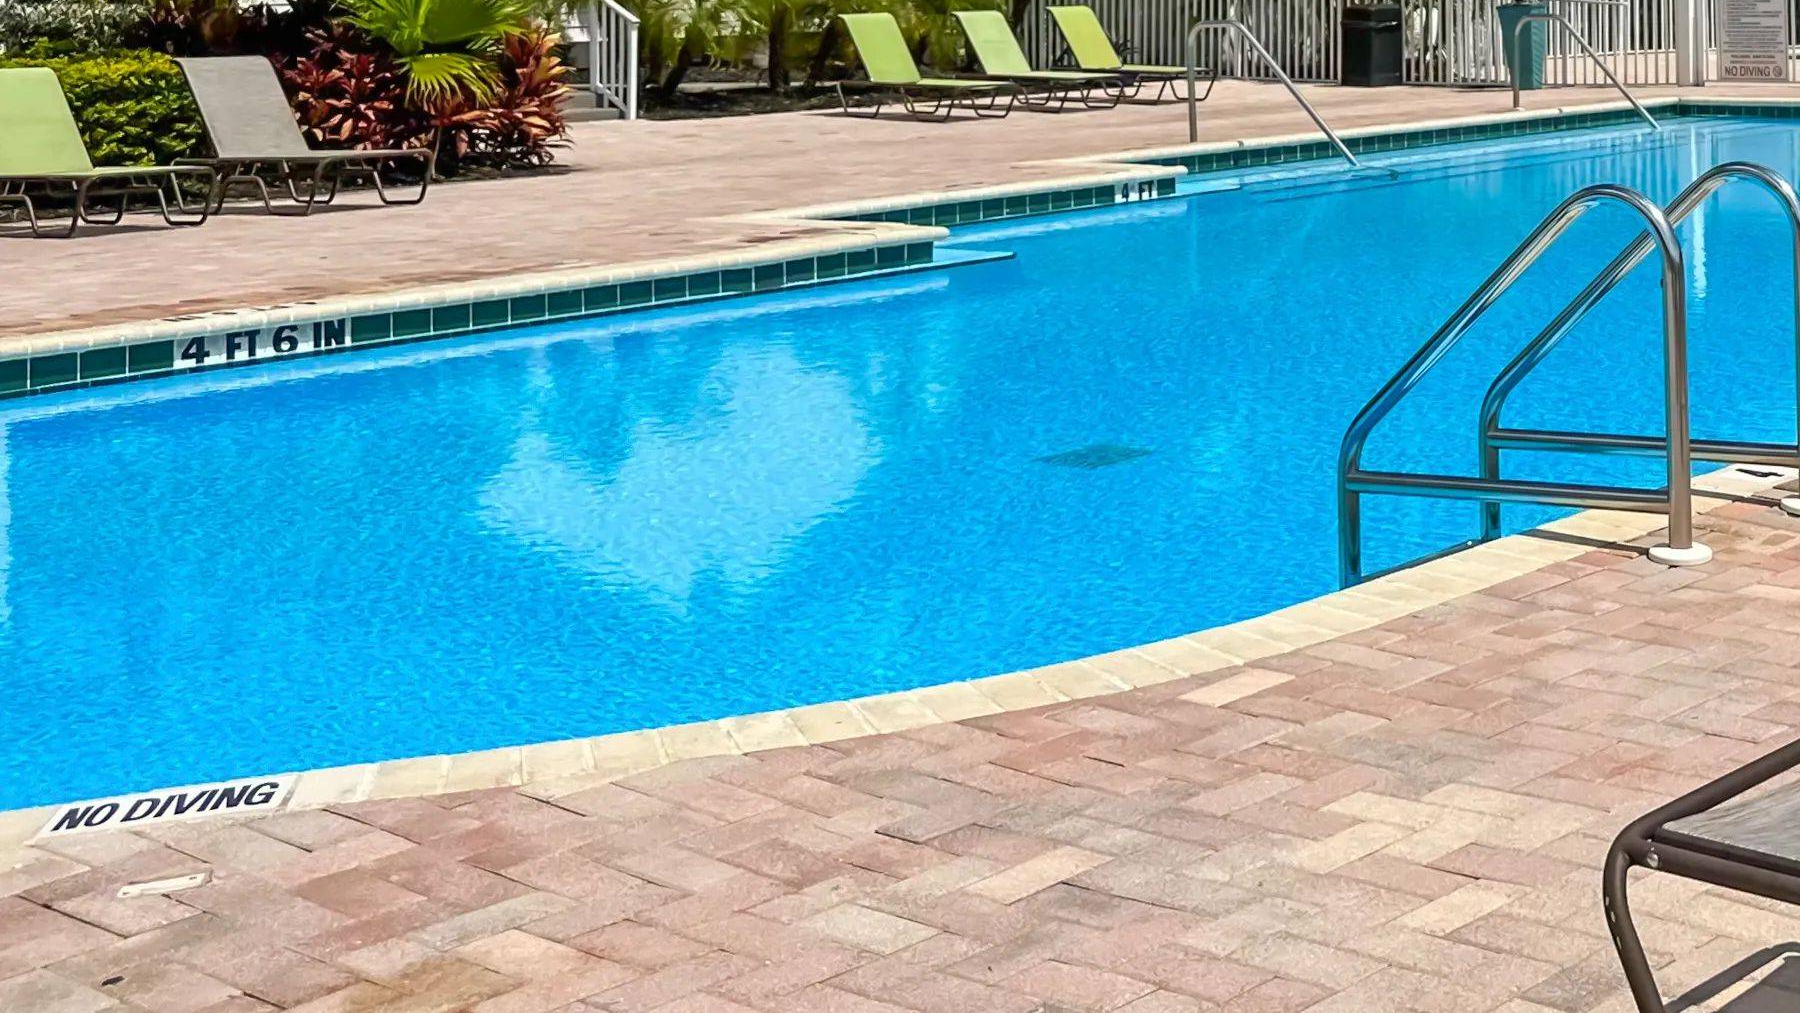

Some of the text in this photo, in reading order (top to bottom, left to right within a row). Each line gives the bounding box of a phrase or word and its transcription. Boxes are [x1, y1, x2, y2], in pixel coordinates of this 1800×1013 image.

[1724, 65, 1771, 77] NO DIVING
[1121, 179, 1155, 204] 4 FT
[181, 318, 346, 364] 4 FT 6 IN
[50, 781, 280, 832] NO DIVING
